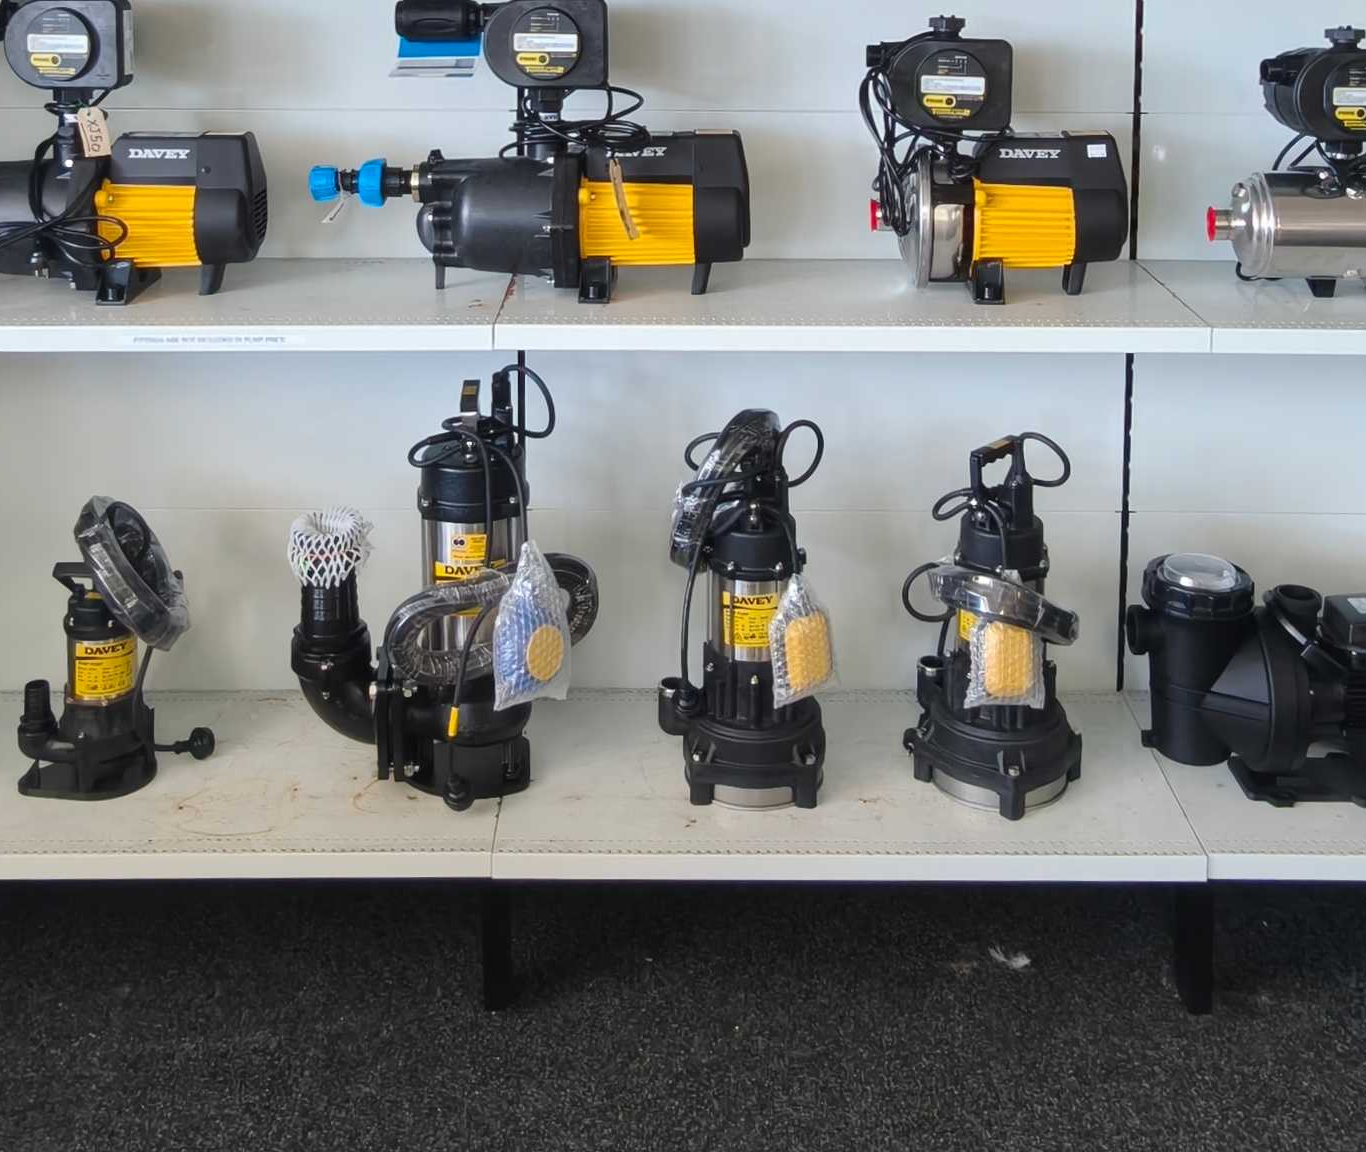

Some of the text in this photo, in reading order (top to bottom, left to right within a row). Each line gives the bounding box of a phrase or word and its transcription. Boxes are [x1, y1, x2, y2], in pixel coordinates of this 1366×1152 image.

[128, 148, 190, 159] DAVEY
[999, 149, 1061, 159] DAVEY
[445, 565, 480, 576] DAV
[732, 596, 773, 605] DAVEY
[85, 642, 127, 655] DAVEY
